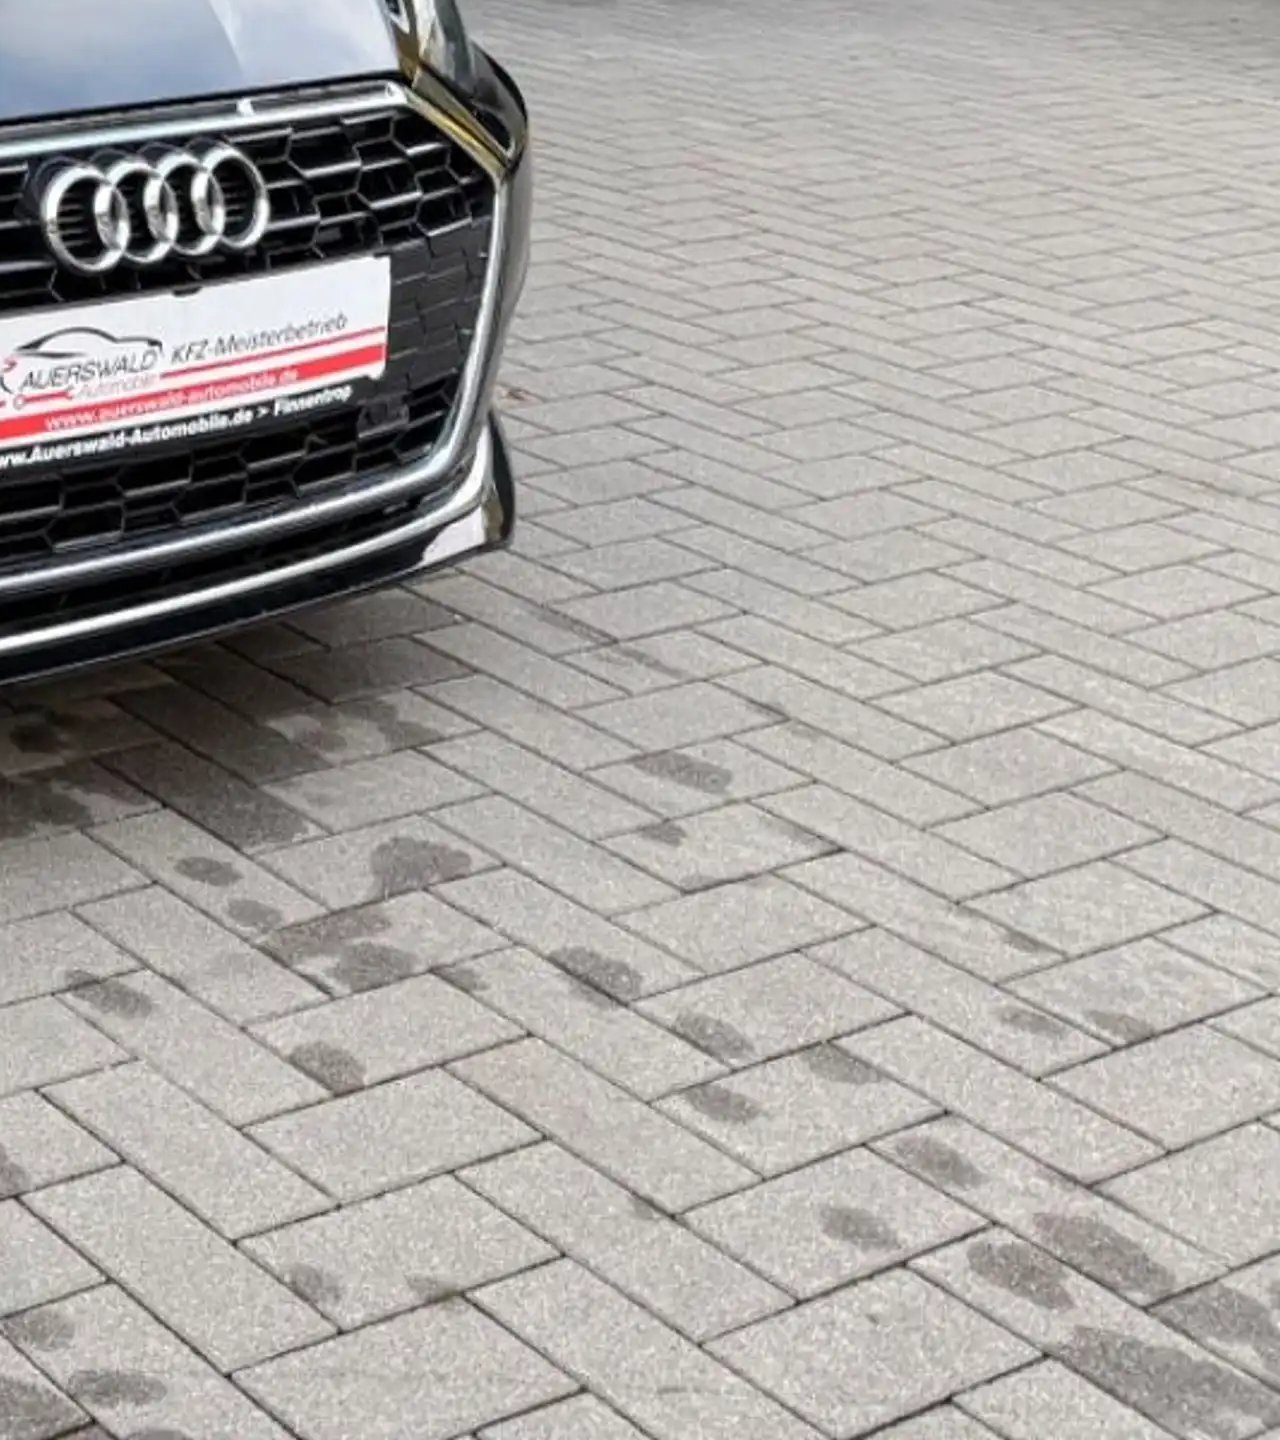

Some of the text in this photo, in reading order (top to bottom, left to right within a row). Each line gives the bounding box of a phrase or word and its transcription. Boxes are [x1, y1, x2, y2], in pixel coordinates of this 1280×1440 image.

[18, 311, 348, 392] AUERSWALD KFZ-Meisterbetrieb
[273, 384, 354, 418] Finnentrop
